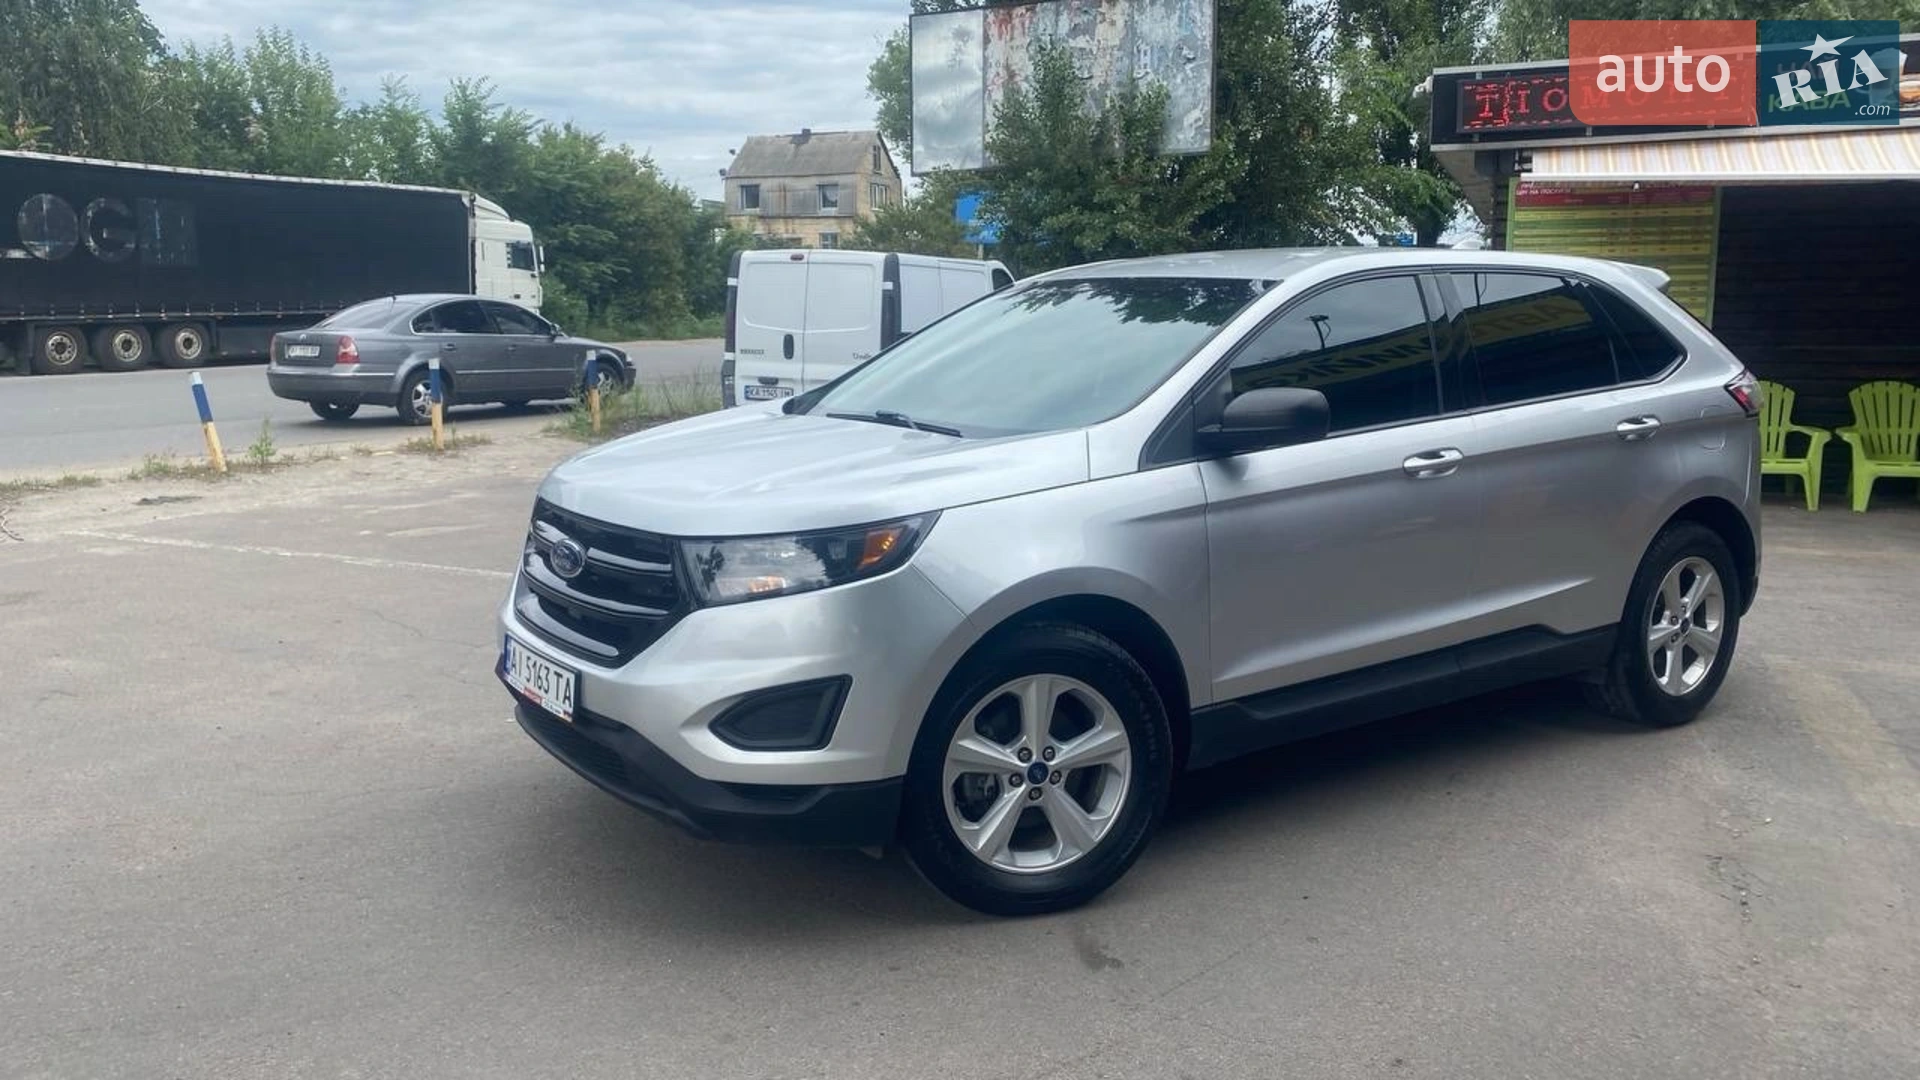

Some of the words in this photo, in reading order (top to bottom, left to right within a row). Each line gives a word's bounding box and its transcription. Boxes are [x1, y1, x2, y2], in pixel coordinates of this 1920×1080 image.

[511, 646, 523, 677] AI
[525, 656, 550, 694] 5163
[554, 671, 572, 708] TA
